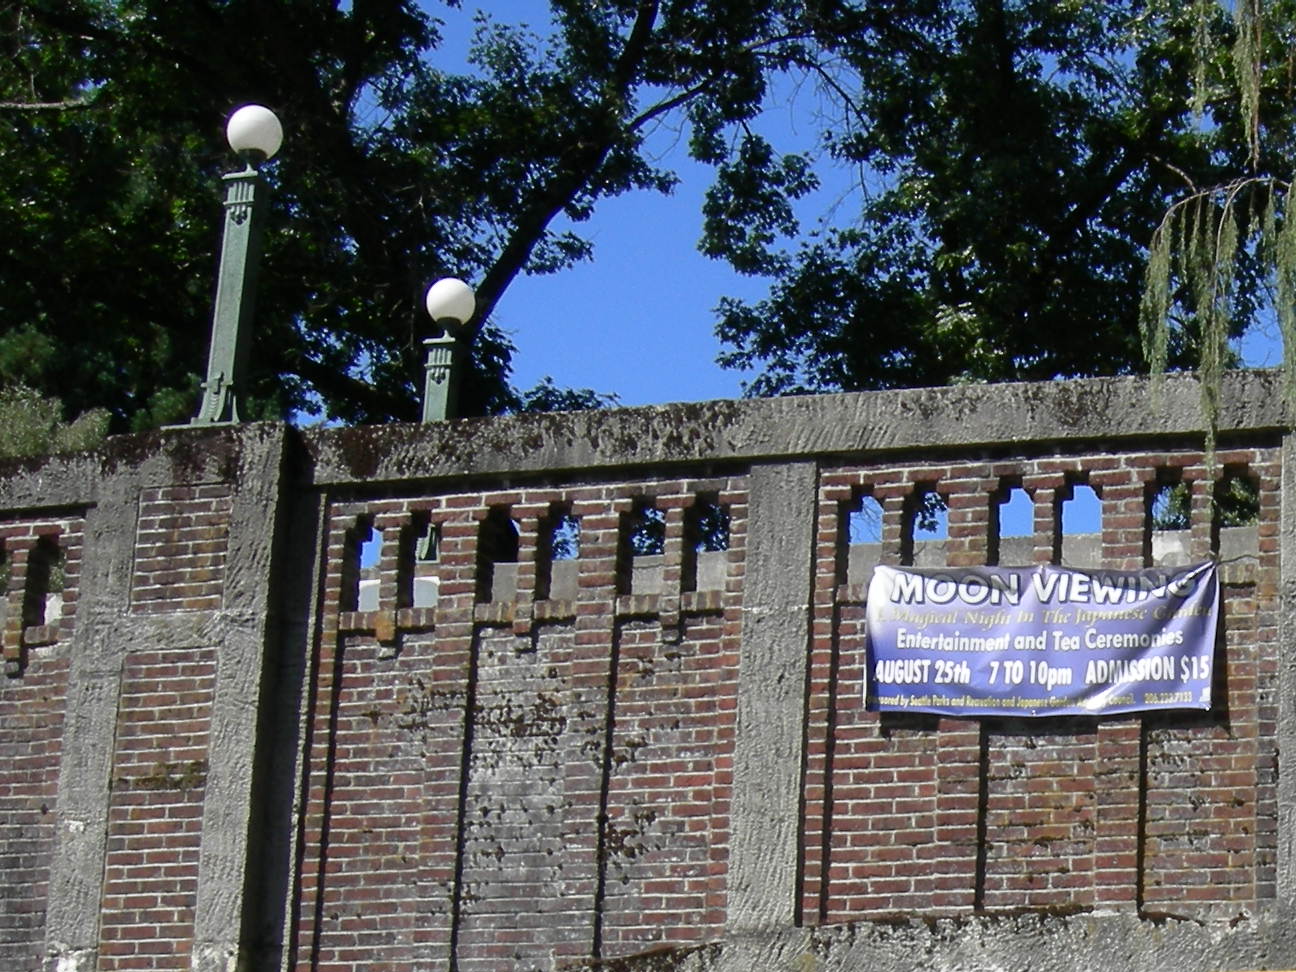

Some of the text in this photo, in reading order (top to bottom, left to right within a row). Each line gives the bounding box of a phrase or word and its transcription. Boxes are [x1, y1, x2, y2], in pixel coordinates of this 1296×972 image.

[890, 573, 1020, 605] MOON
[964, 610, 1010, 630] Night
[1042, 609, 1072, 624] The
[1074, 609, 1148, 628] Japanese
[896, 627, 1184, 651] Entertainment and Tea Ceremonies
[874, 654, 1210, 692] AUGUST 25th 7 TO 10pm ADMISSION $15
